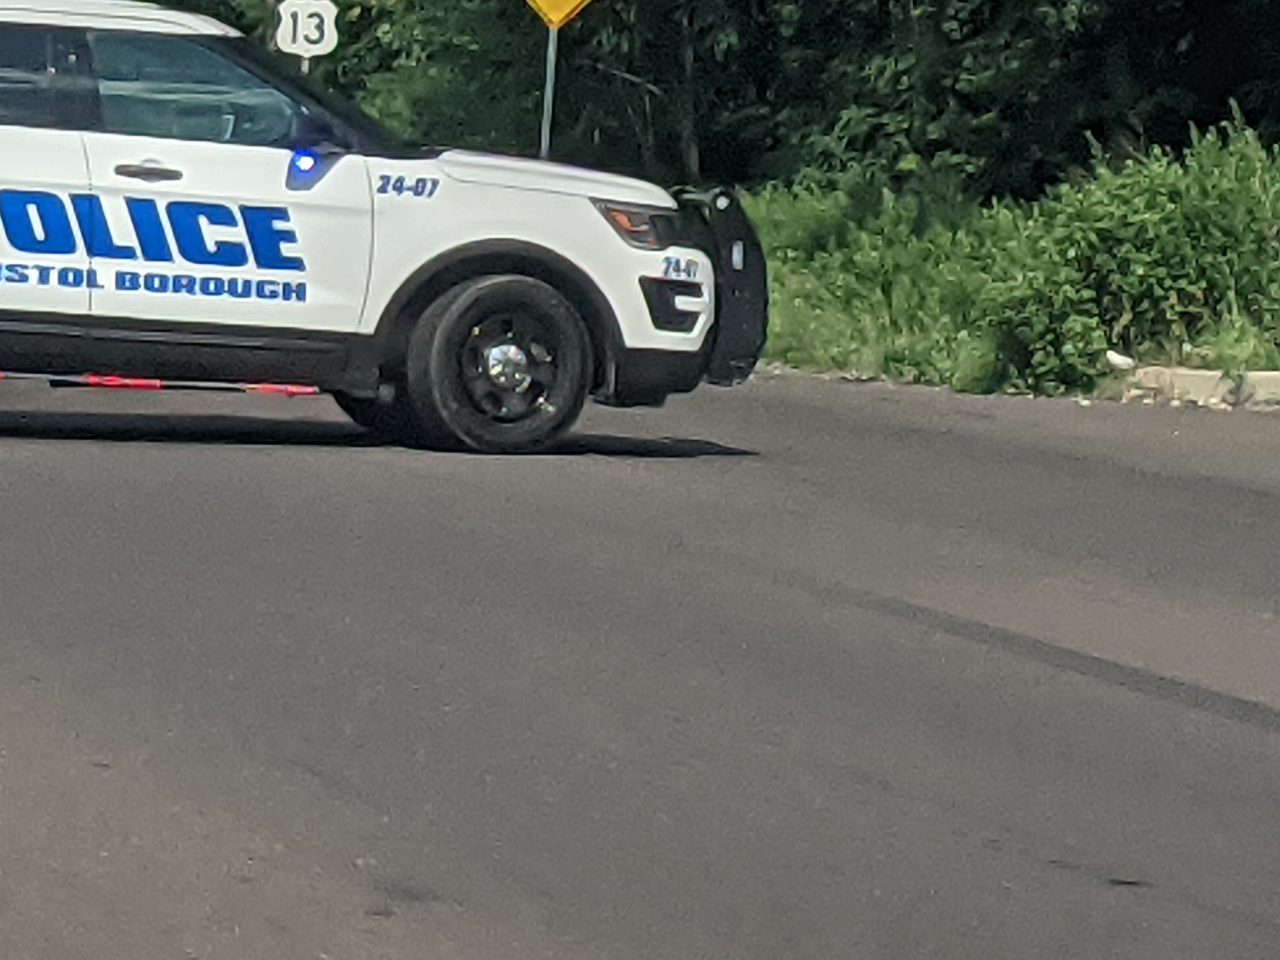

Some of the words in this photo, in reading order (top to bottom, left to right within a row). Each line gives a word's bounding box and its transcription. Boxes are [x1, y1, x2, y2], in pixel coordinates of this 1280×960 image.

[290, 10, 325, 45] 13
[376, 174, 440, 198] 24-07
[115, 271, 307, 302] BOROUGH
